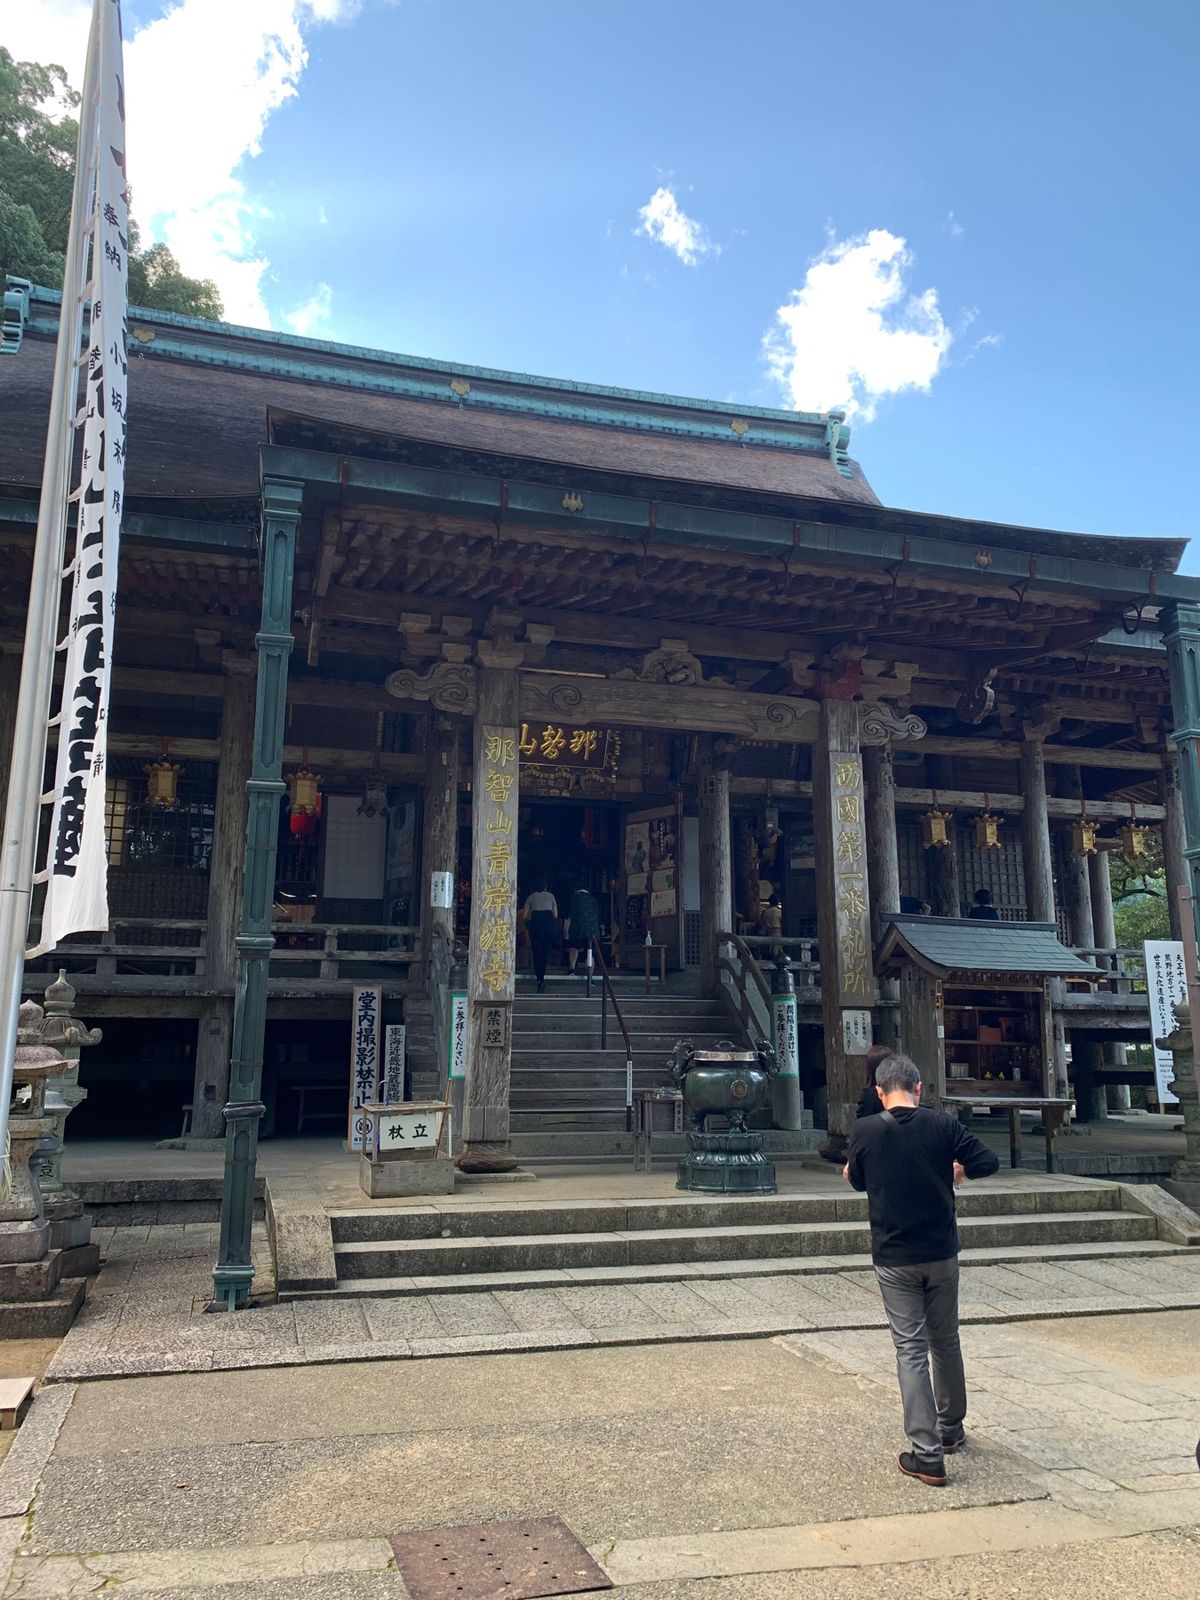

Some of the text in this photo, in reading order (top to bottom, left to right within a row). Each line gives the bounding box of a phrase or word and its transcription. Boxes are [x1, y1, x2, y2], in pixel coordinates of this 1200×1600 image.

[480, 735, 515, 992] 那智山青岸渡寺
[833, 761, 868, 995] 西國第一番札所
[354, 991, 377, 1110] 堂内撮影禁止
[485, 1009, 502, 1044] 禁煙
[786, 1005, 796, 1058] 間隔をあけて
